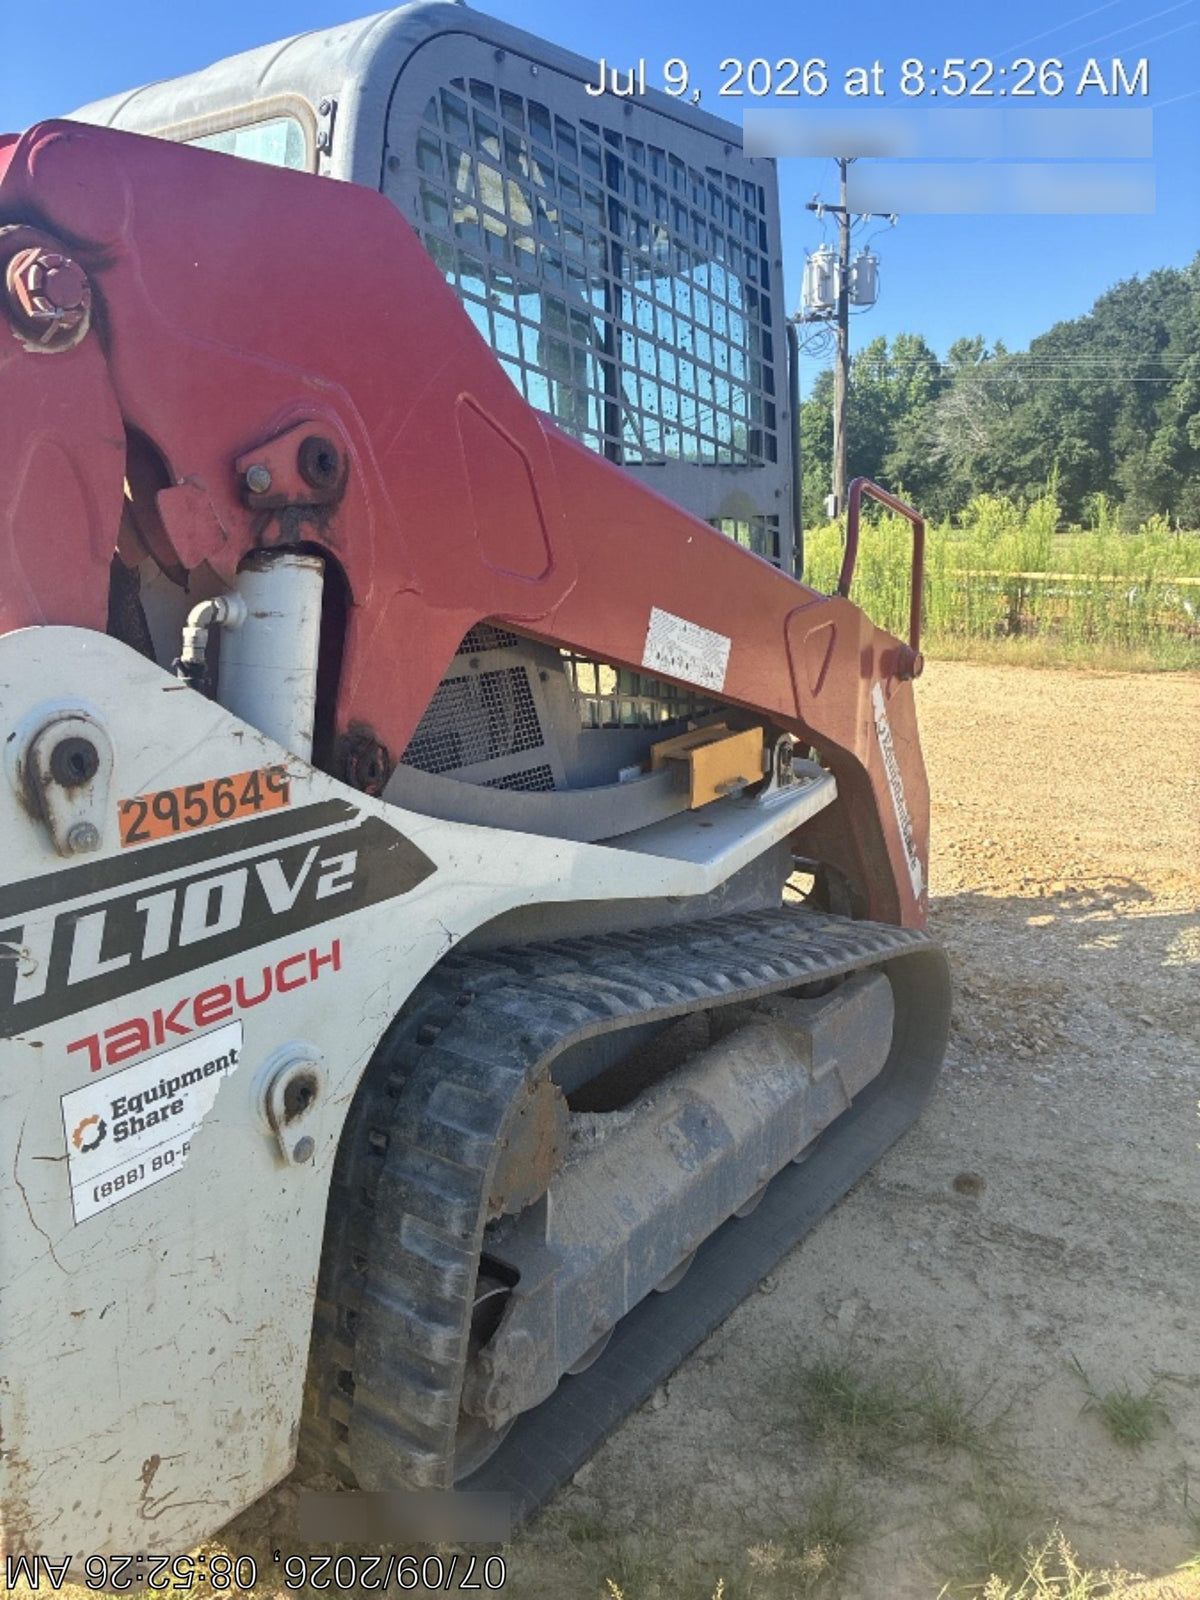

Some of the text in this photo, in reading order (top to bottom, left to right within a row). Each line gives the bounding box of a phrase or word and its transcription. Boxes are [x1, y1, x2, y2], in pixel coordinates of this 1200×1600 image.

[121, 765, 290, 844] 295649
[110, 1048, 239, 1121] Equipment
[112, 1098, 185, 1143] Share
[93, 1164, 145, 1202] (888)
